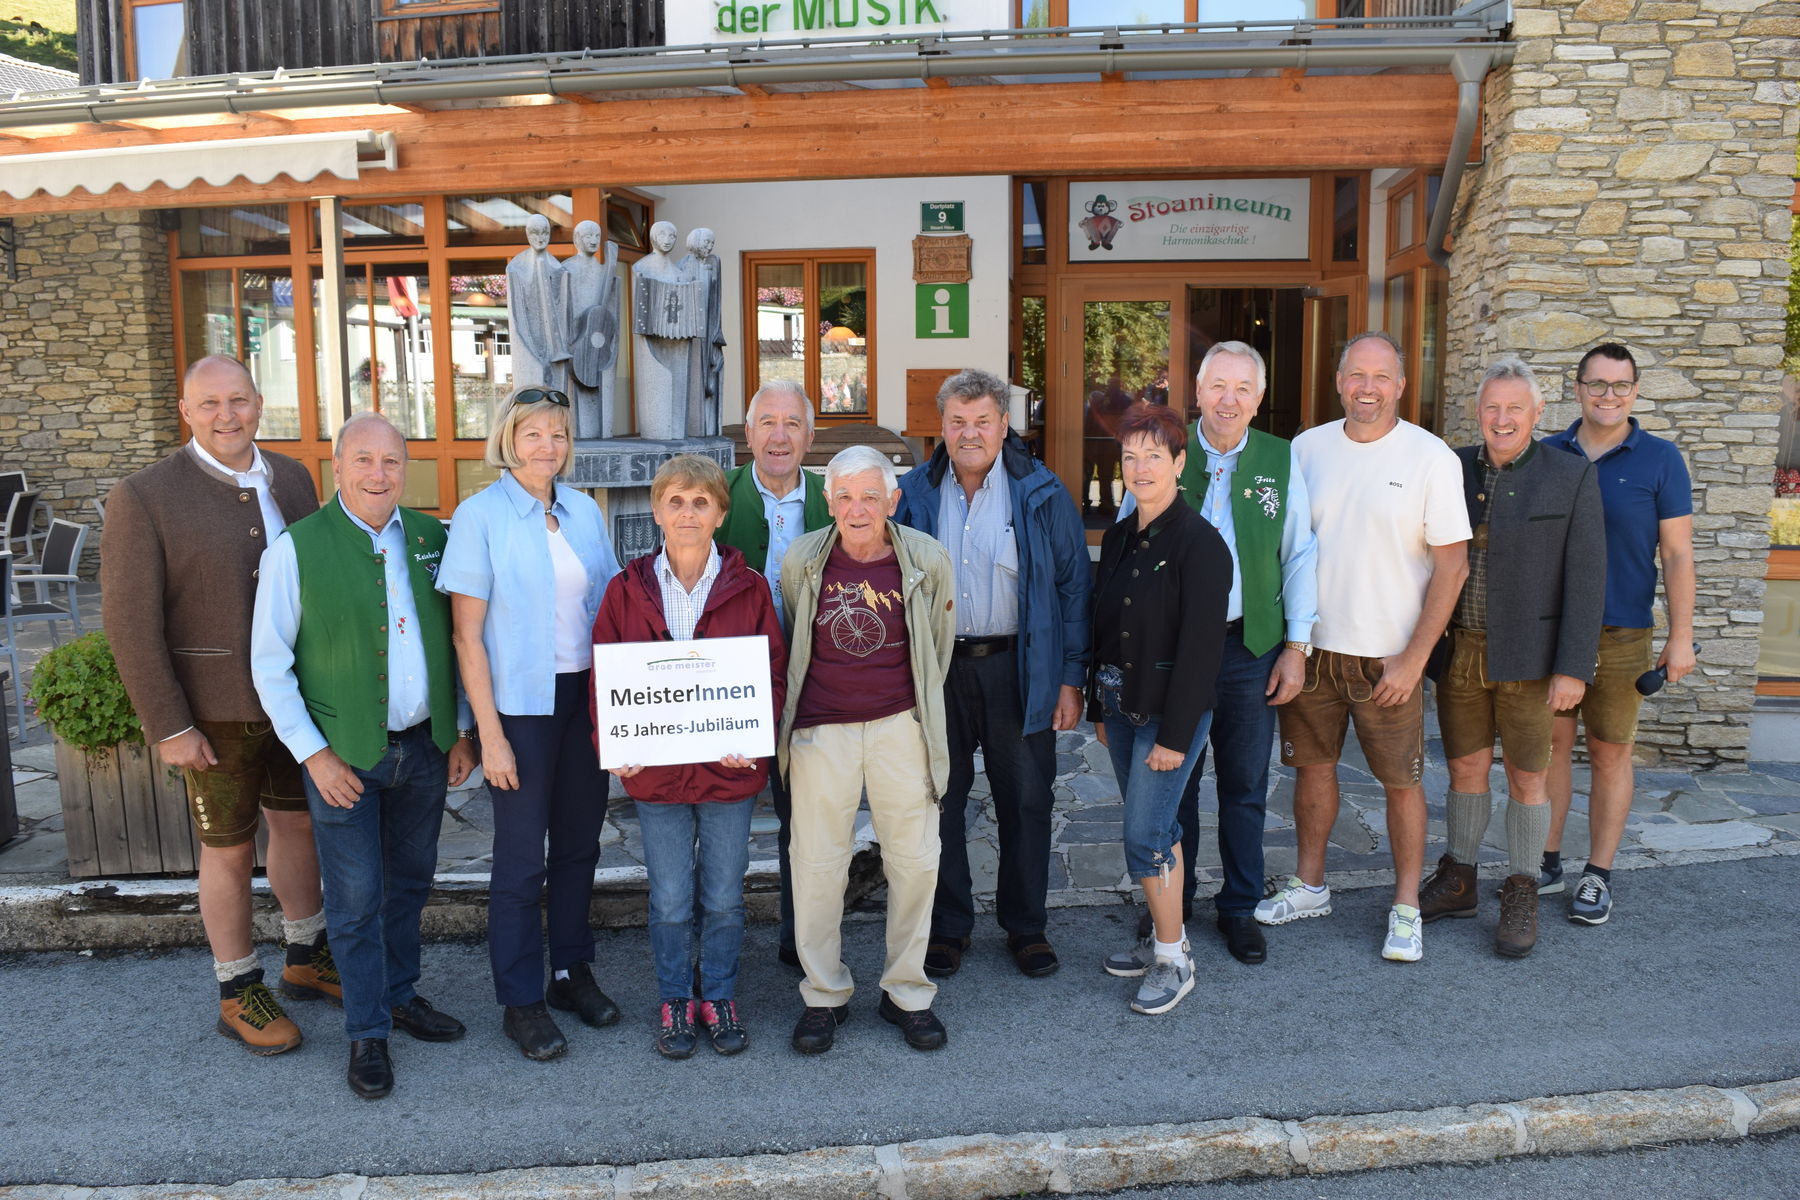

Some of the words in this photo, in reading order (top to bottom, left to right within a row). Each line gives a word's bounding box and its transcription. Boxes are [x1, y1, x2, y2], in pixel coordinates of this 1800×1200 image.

[718, 0, 781, 34] der
[1128, 193, 1293, 223] Stoanineum
[938, 211, 947, 223] 9
[1170, 223, 1188, 234] Die
[1190, 223, 1250, 237] einzigartige
[1162, 234, 1250, 246] Harmonikaschule
[674, 660, 717, 670] meister
[610, 684, 756, 707] MeisterInnen
[610, 725, 629, 738] 45
[634, 717, 760, 737] Jahres-Jubiläum
